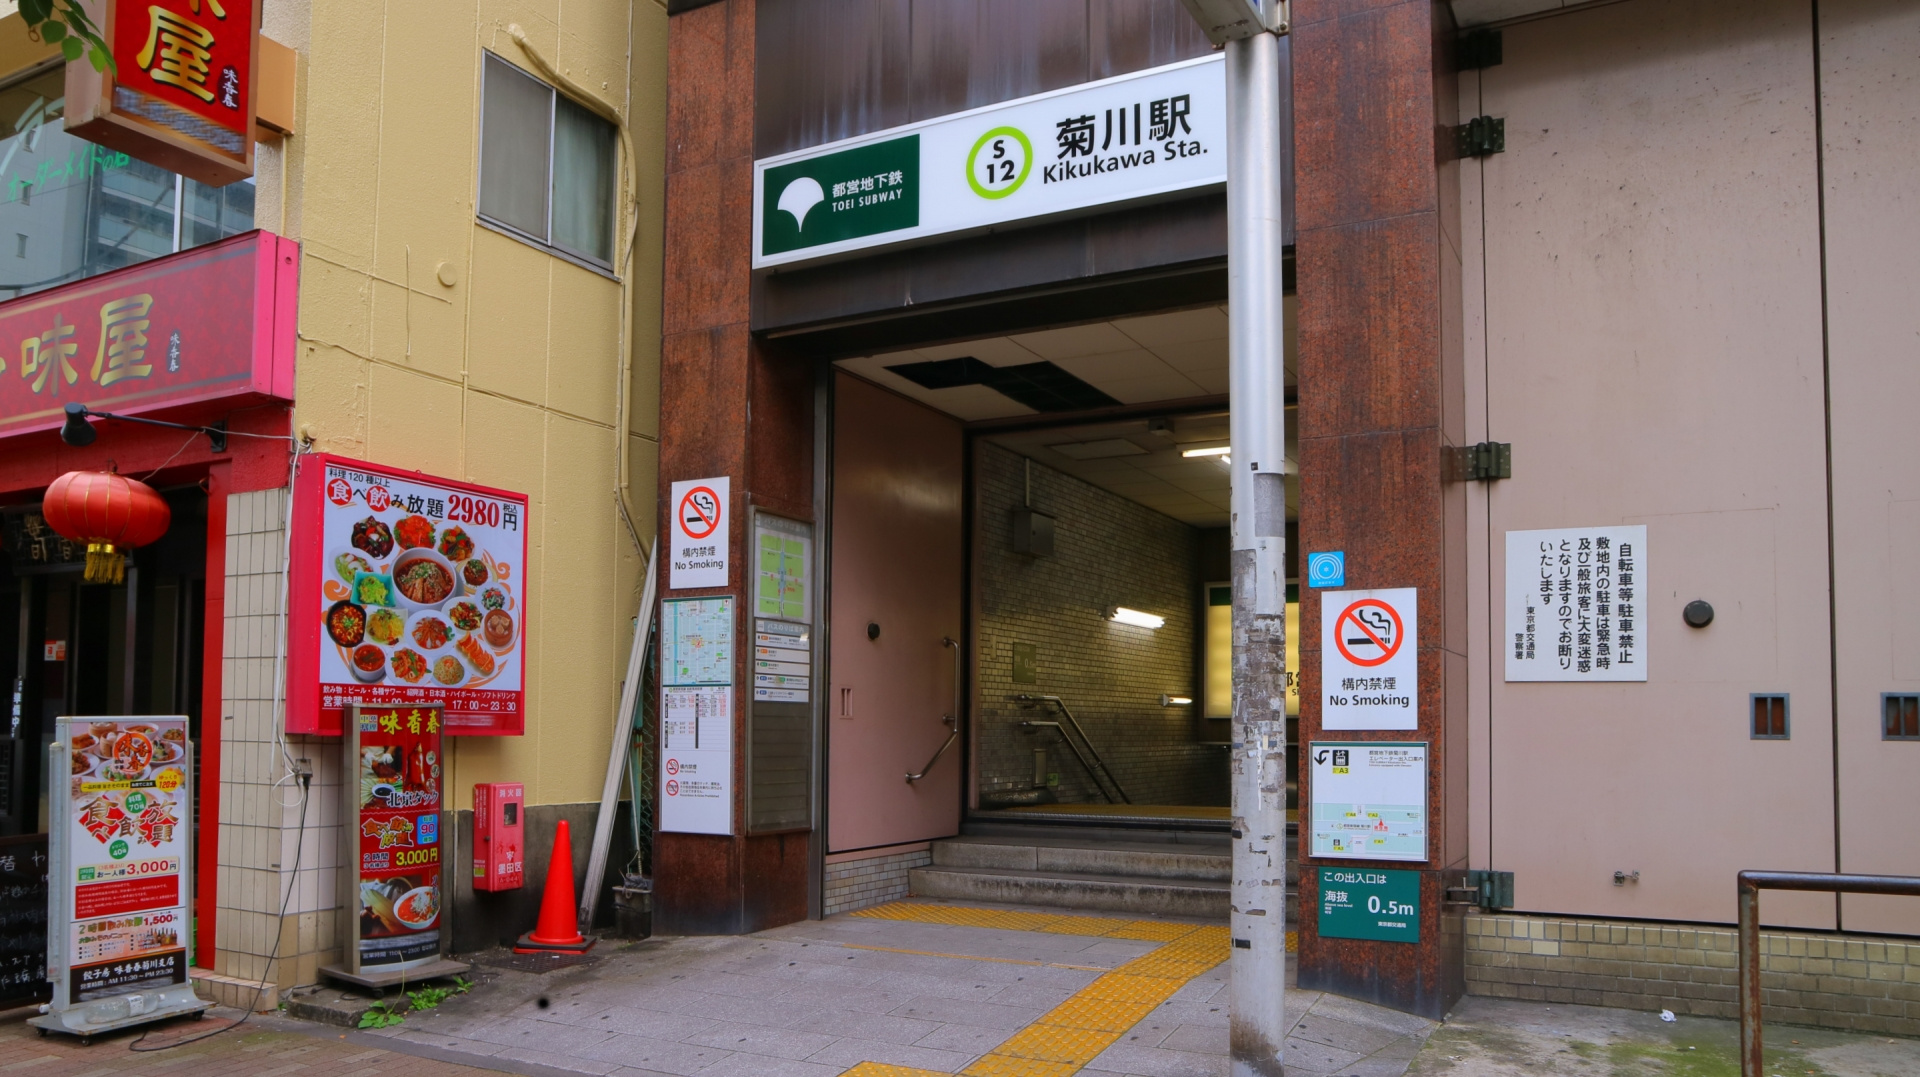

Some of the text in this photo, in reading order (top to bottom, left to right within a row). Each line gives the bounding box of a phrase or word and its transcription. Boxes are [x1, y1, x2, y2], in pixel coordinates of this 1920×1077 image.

[221, 68, 238, 108] 味香春
[1055, 94, 1192, 159] 菊川駅
[993, 140, 1005, 159] S
[1043, 140, 1208, 184] Kikukawa Sta.
[832, 170, 903, 198] 都営地下鉄
[986, 160, 1015, 184] 12
[832, 188, 902, 212] TOEI SUBWAY
[0, 293, 153, 397] 味屋
[169, 332, 181, 373] 味香春
[329, 468, 390, 488] 料理 120 種以上
[329, 479, 517, 531] 食べ飲み放題 2980 円
[502, 502, 518, 514] 税込
[675, 559, 724, 571] No Smoking
[682, 546, 716, 559] 構内禁煙
[1540, 541, 1553, 605] いたします
[1558, 539, 1572, 670] となりますのでお断り
[1577, 538, 1591, 673] 及び一般旅客に大変迷惑
[1596, 536, 1610, 670] 敷地内の駐車は緊急時
[1618, 542, 1634, 664] 自転車等駐車禁止
[1526, 606, 1535, 660] 東京都交通局
[1514, 633, 1524, 660] 警察署
[1341, 677, 1397, 691] 構内禁煙
[1329, 694, 1410, 708] No Smoking
[379, 708, 440, 737] 味香春
[387, 791, 439, 808] 北京ダック
[499, 788, 522, 798] 消火器
[420, 823, 435, 835] 90
[498, 861, 522, 875] 墨田区
[1323, 872, 1387, 885] この出入口は
[1324, 890, 1414, 916] 海抜 0.5m
